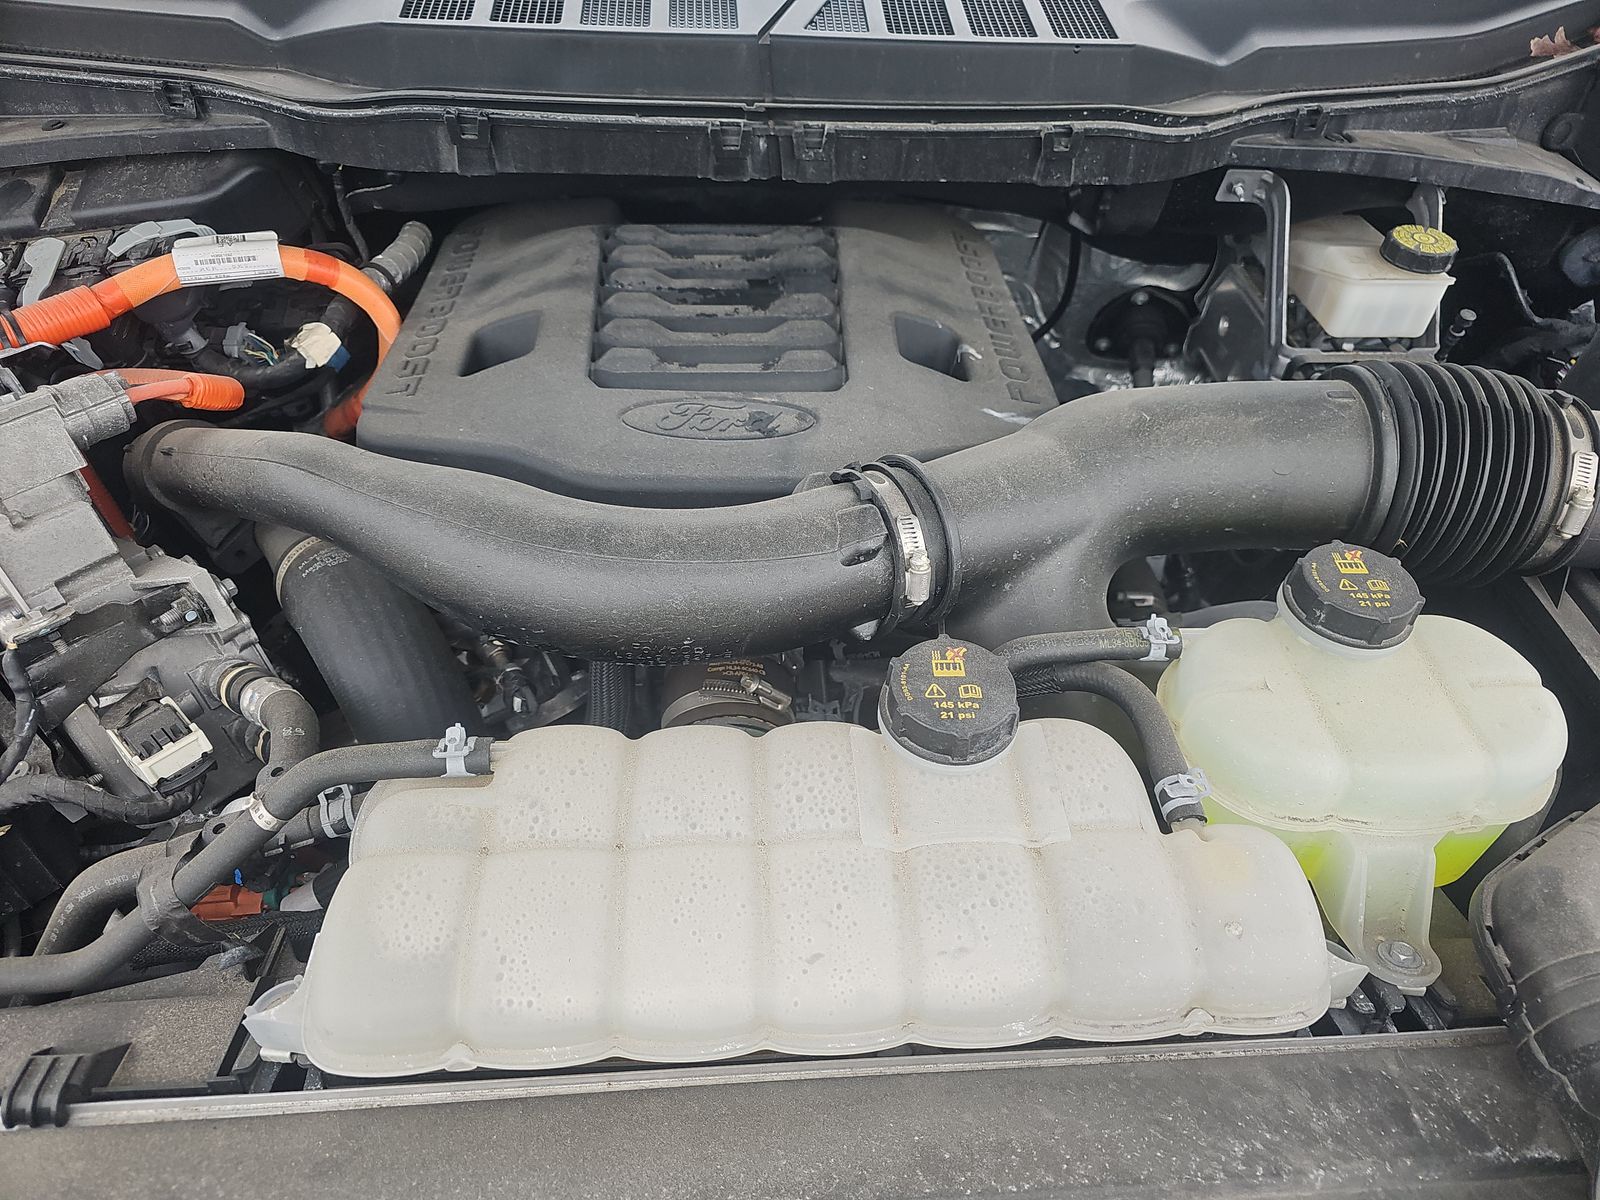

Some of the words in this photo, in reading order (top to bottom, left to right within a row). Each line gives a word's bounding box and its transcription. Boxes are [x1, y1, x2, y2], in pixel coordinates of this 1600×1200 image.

[385, 226, 487, 396] POWERBOOST
[953, 230, 1041, 404] POWERBOOST
[655, 402, 783, 432] Ford
[1374, 600, 1391, 608] psi
[933, 701, 955, 709] 145
[958, 701, 980, 709] kPa
[958, 711, 976, 720] psi
